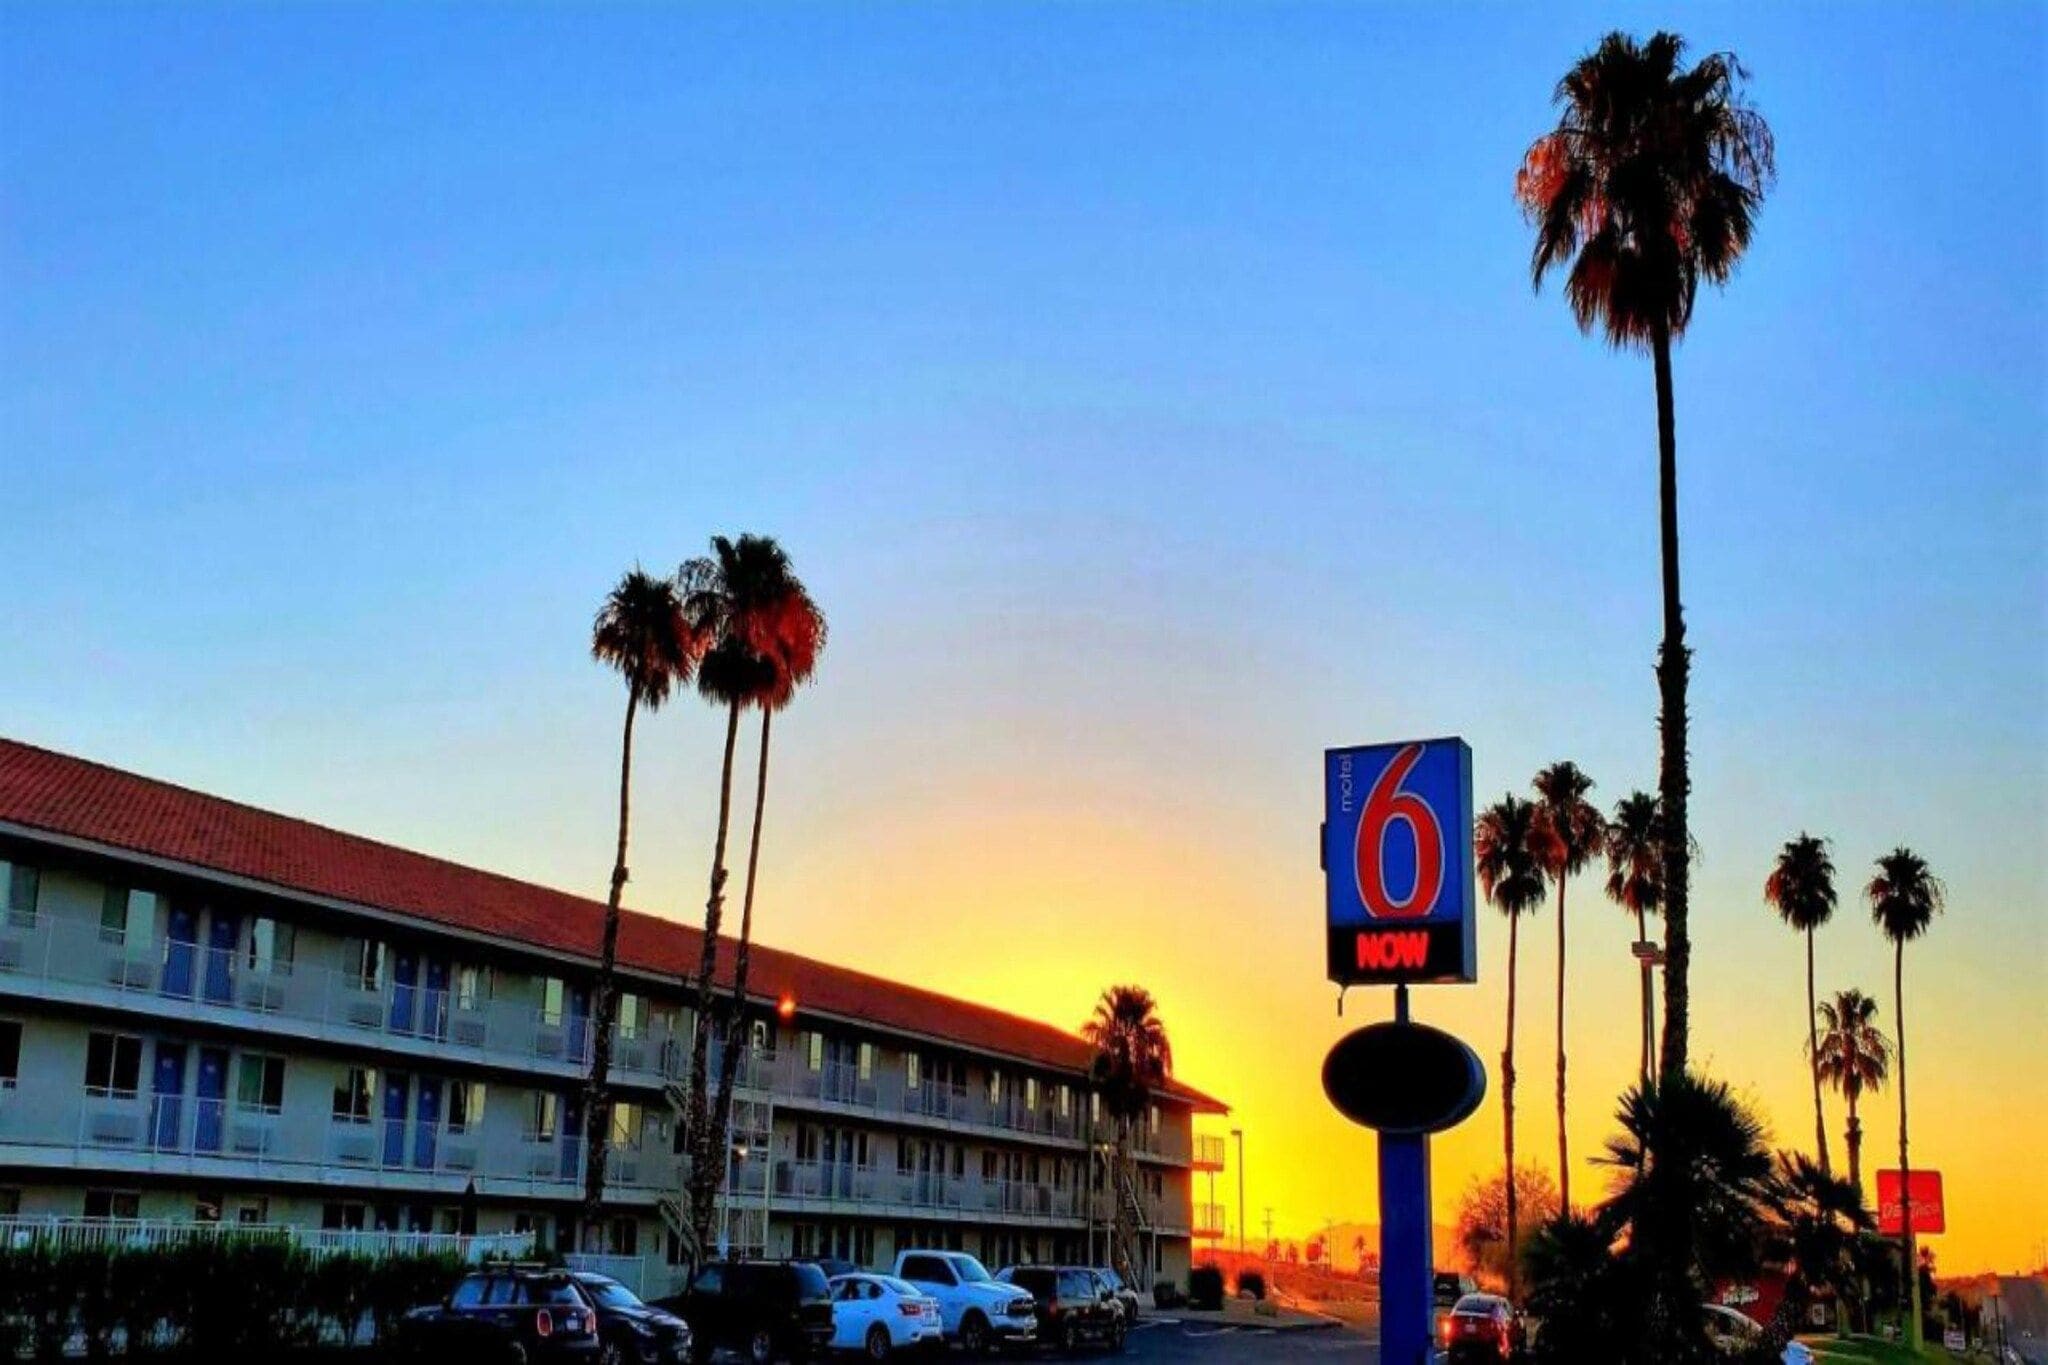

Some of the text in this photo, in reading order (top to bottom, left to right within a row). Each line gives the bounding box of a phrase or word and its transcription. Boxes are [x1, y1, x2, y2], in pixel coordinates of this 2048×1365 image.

[1339, 743, 1446, 918] motel 6
[1356, 931, 1430, 969] NOW
